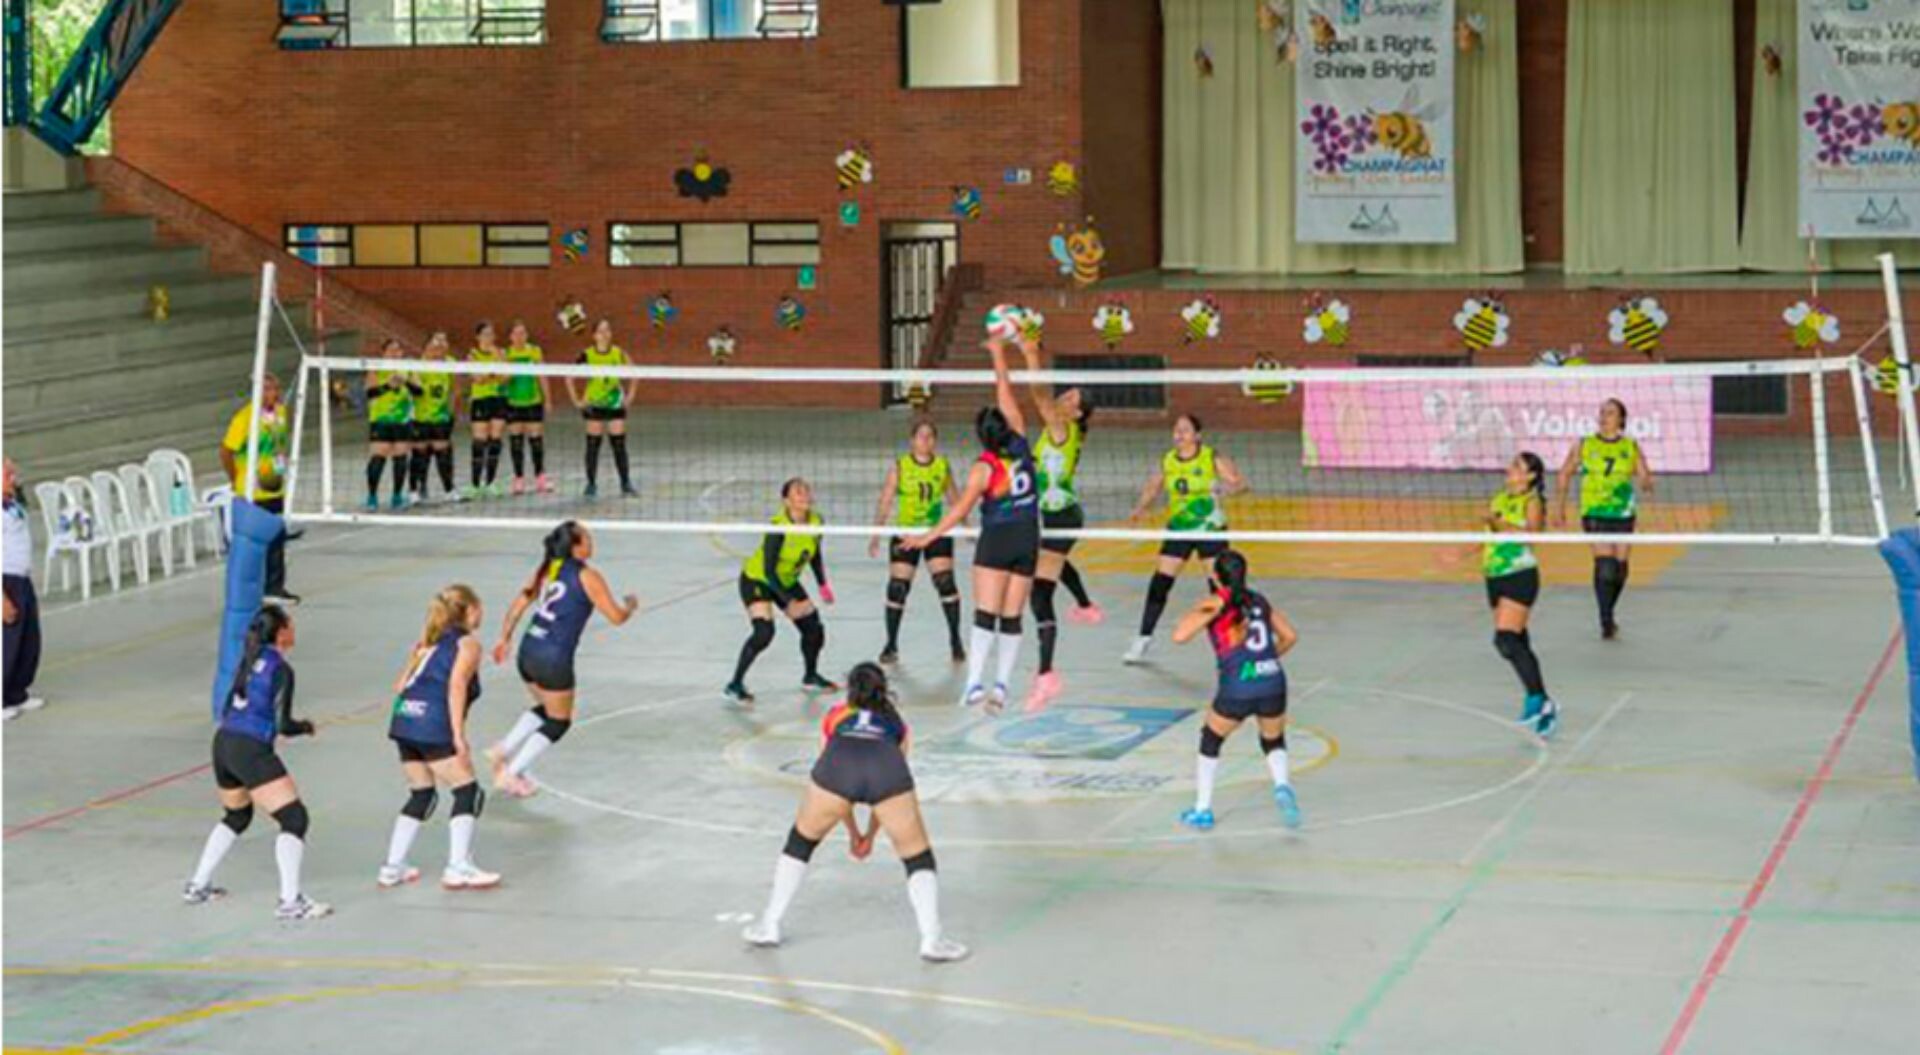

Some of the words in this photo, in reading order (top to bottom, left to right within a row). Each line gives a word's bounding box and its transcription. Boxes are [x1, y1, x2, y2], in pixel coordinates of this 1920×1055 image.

[1314, 60, 1366, 78] Shine
[1603, 456, 1616, 477] 7
[1010, 459, 1030, 496] 6
[1174, 478, 1188, 495] 9
[918, 481, 933, 503] 11
